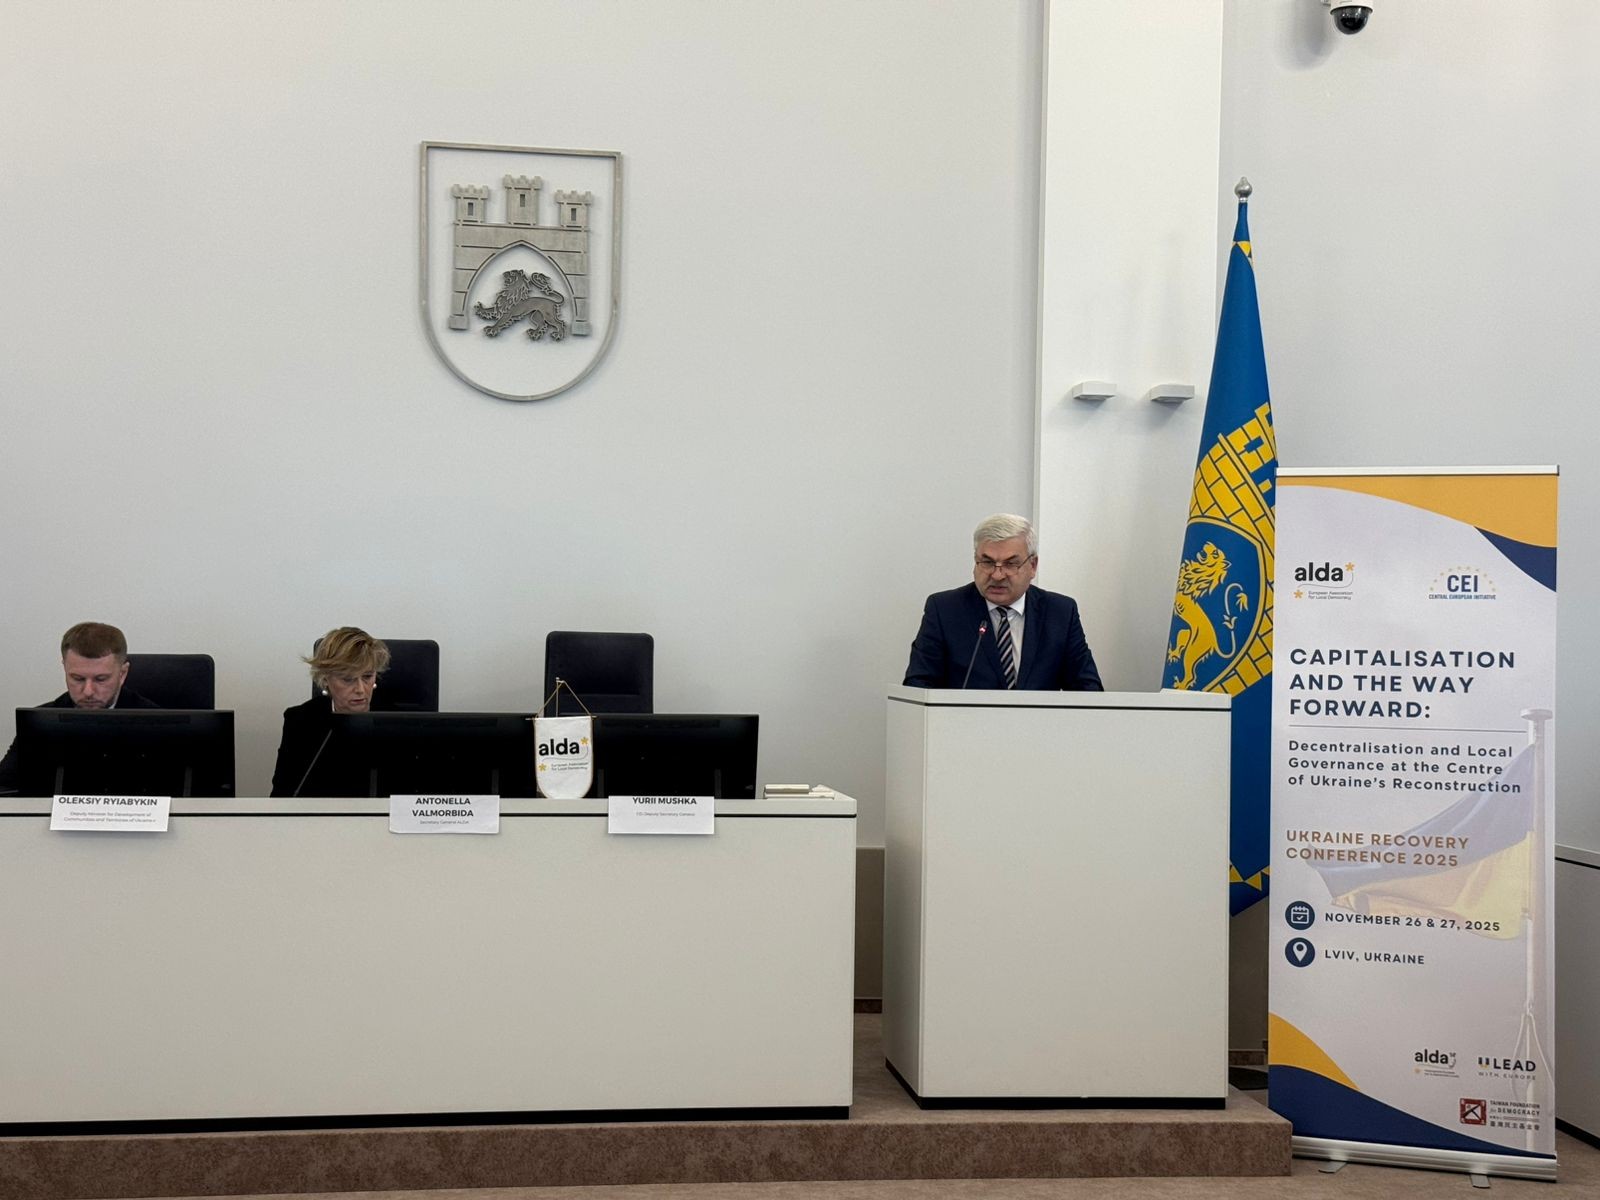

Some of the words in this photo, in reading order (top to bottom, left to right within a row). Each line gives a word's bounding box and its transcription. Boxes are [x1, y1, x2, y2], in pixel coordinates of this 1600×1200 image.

[1294, 562, 1344, 582] alda
[1447, 574, 1479, 592] CEI
[1290, 648, 1514, 668] CAPITALISATION
[1290, 674, 1343, 691] AND
[1354, 675, 1402, 692] THE
[1412, 676, 1474, 693] WAY
[1290, 699, 1431, 718] FORWARD:
[538, 738, 580, 756] alda
[1289, 740, 1423, 755] Decentralisation
[1430, 744, 1460, 756] and
[1468, 746, 1512, 757] Local
[1288, 758, 1384, 771] Governance
[1391, 761, 1406, 772] at
[1414, 762, 1440, 773] the
[1447, 763, 1503, 775] Centre
[1288, 775, 1304, 786] of
[1310, 776, 1386, 788] Ukraine’s
[1393, 778, 1521, 793] Reconstruction
[58, 797, 102, 805] OLEKSIY
[103, 798, 158, 806] RYIABYKIN
[1287, 830, 1364, 844] UKRAINE
[1371, 834, 1469, 849] RECOVERY
[1286, 848, 1406, 864] CONFERENCE
[1413, 854, 1458, 866] 2025
[1325, 912, 1400, 926] NOVEMBER
[1405, 917, 1422, 927] 26
[1426, 918, 1435, 928] &
[1440, 919, 1460, 930] 27,
[1465, 921, 1500, 931] 2025
[1325, 949, 1359, 962] LVIV,
[1364, 952, 1425, 964] UKRAINE
[1415, 1049, 1448, 1064] alda
[1498, 1108, 1540, 1116] DEMOCRACY
